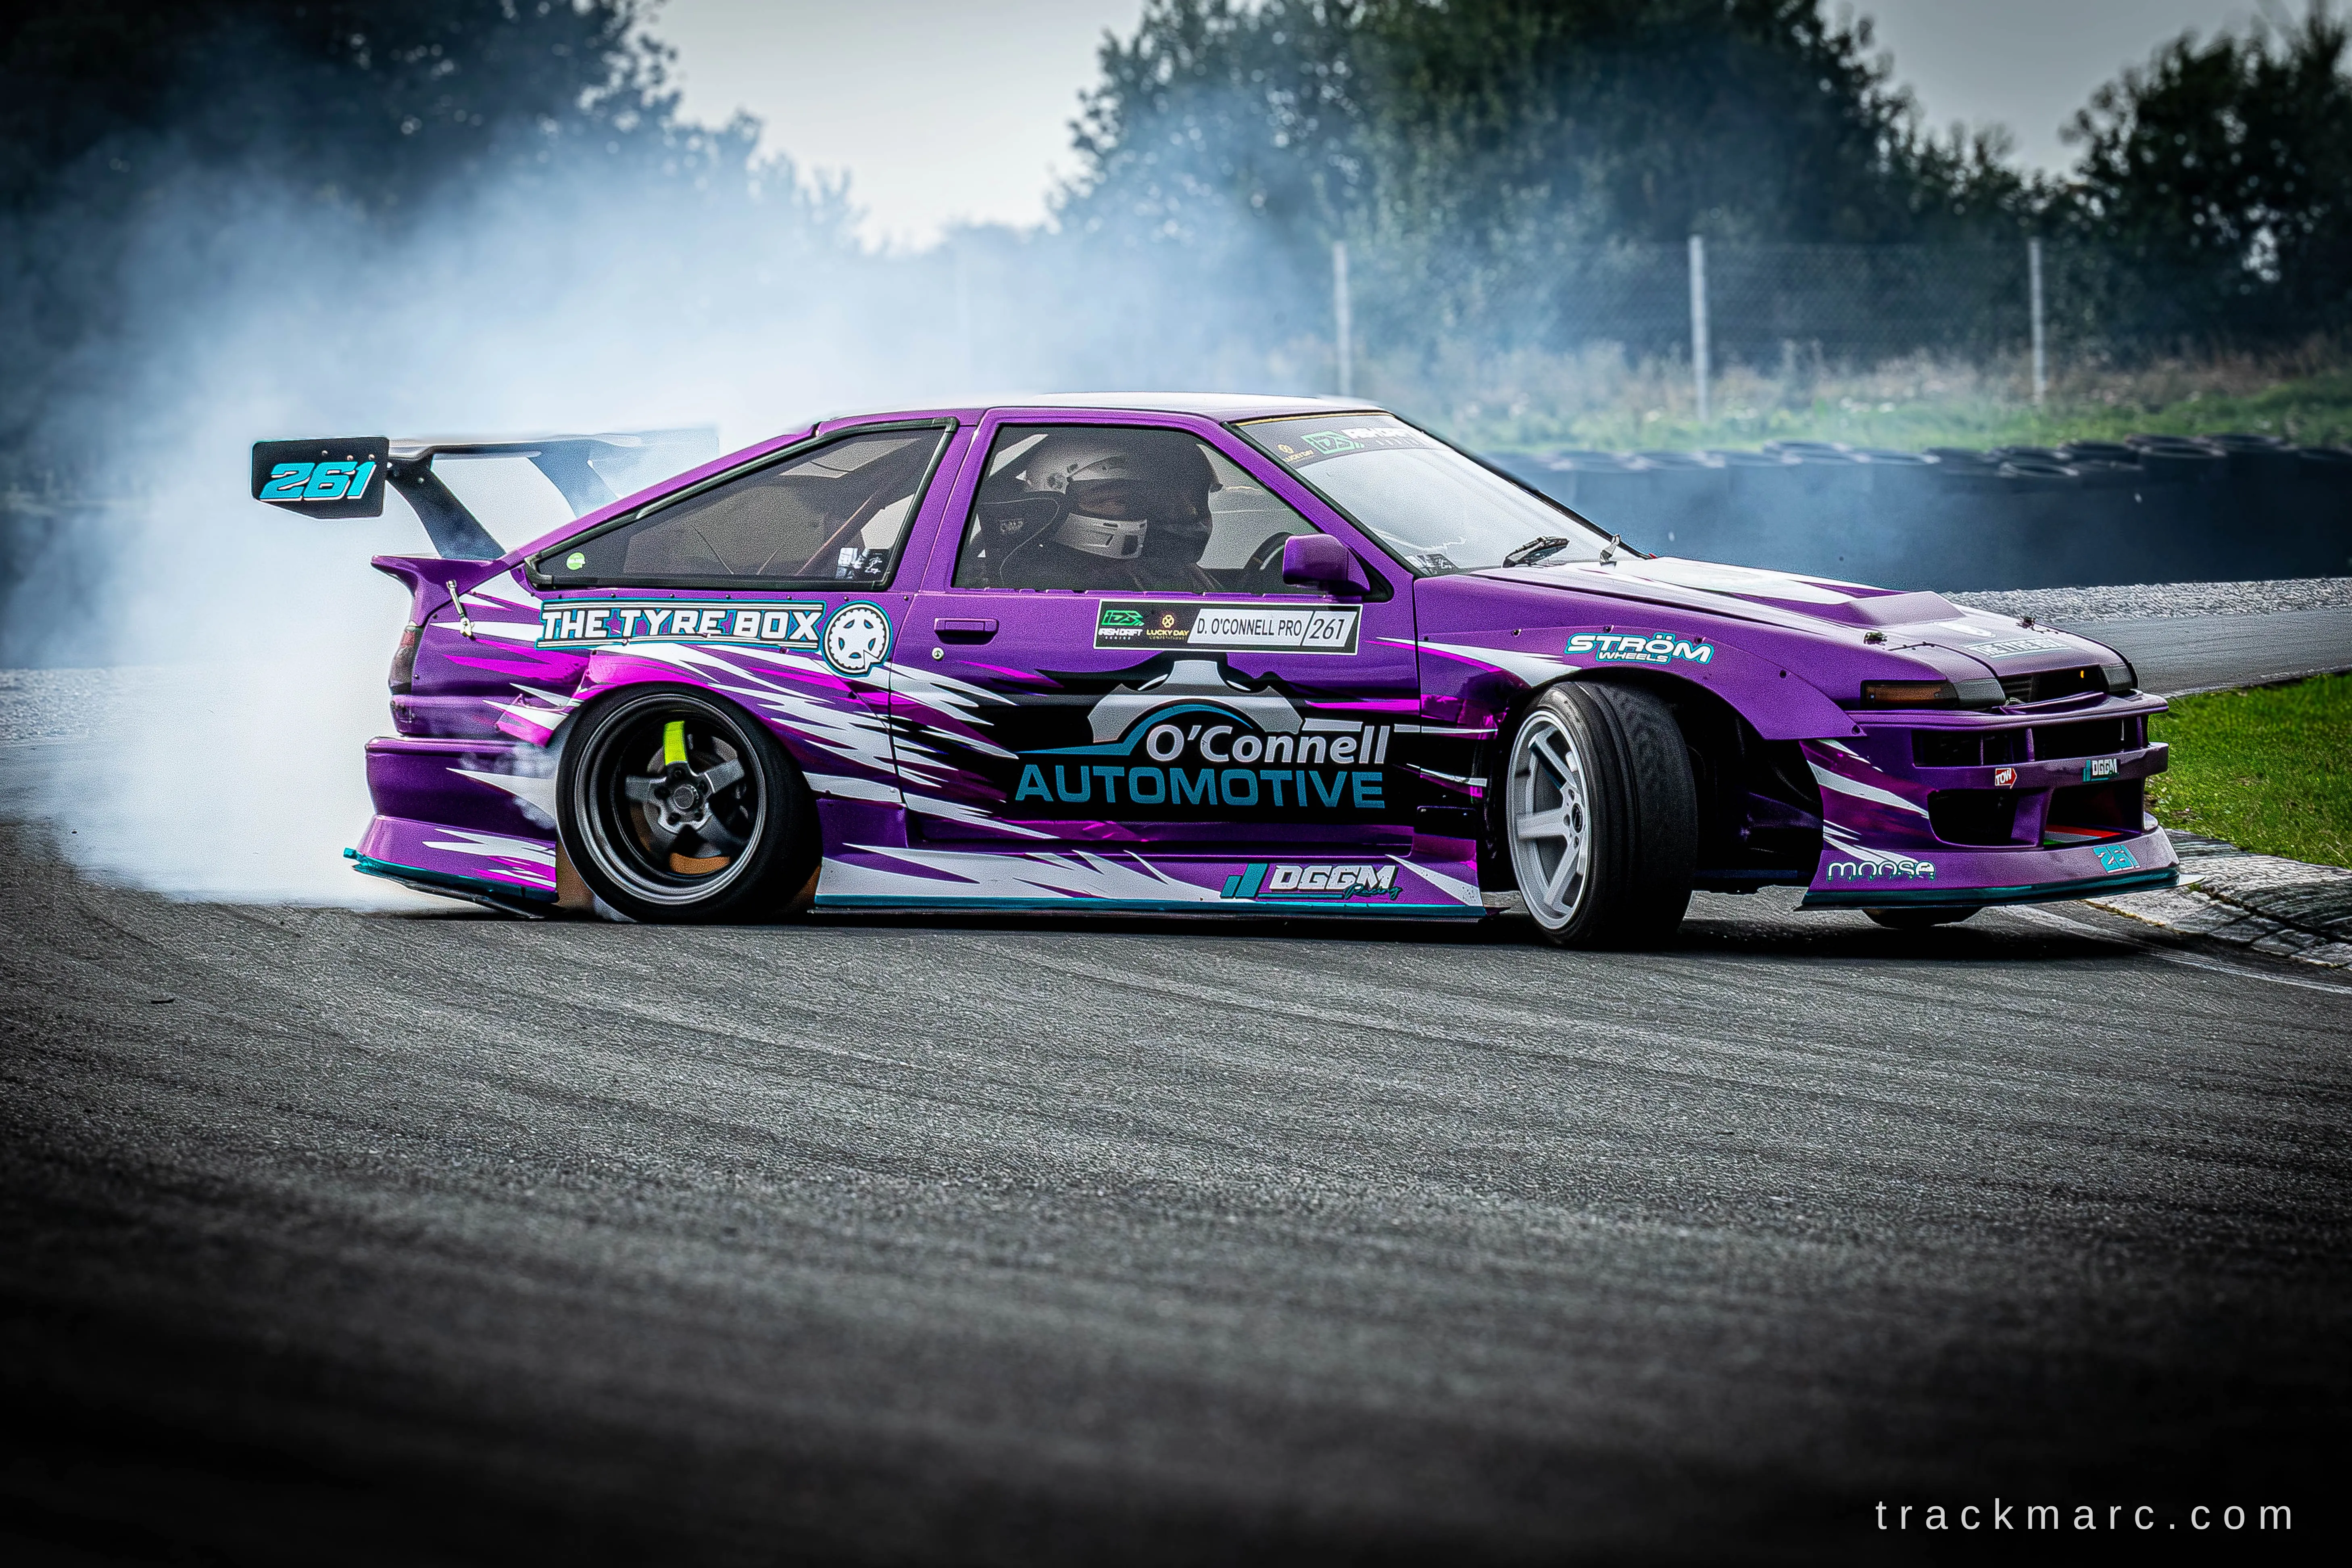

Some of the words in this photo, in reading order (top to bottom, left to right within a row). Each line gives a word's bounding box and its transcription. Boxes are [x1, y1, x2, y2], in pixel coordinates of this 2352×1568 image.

[260, 461, 377, 501] 261
[542, 609, 610, 639] THE
[620, 609, 726, 637] TYRE
[733, 611, 822, 640] BOX
[1197, 618, 1207, 634] D.
[1211, 618, 1274, 636] O'CONNELL
[1278, 619, 1302, 636] PRO
[1308, 618, 1345, 640] 261
[1568, 634, 1711, 663] STRÖM
[1599, 651, 1668, 662] WHEELS
[1147, 725, 1391, 764] O'Connell
[1996, 769, 2012, 785] TOW
[2092, 758, 2117, 776] DGGM
[1015, 764, 1385, 809] AUTOMOTIVE
[2093, 844, 2141, 873] 261
[1269, 865, 1397, 890] DGGM
